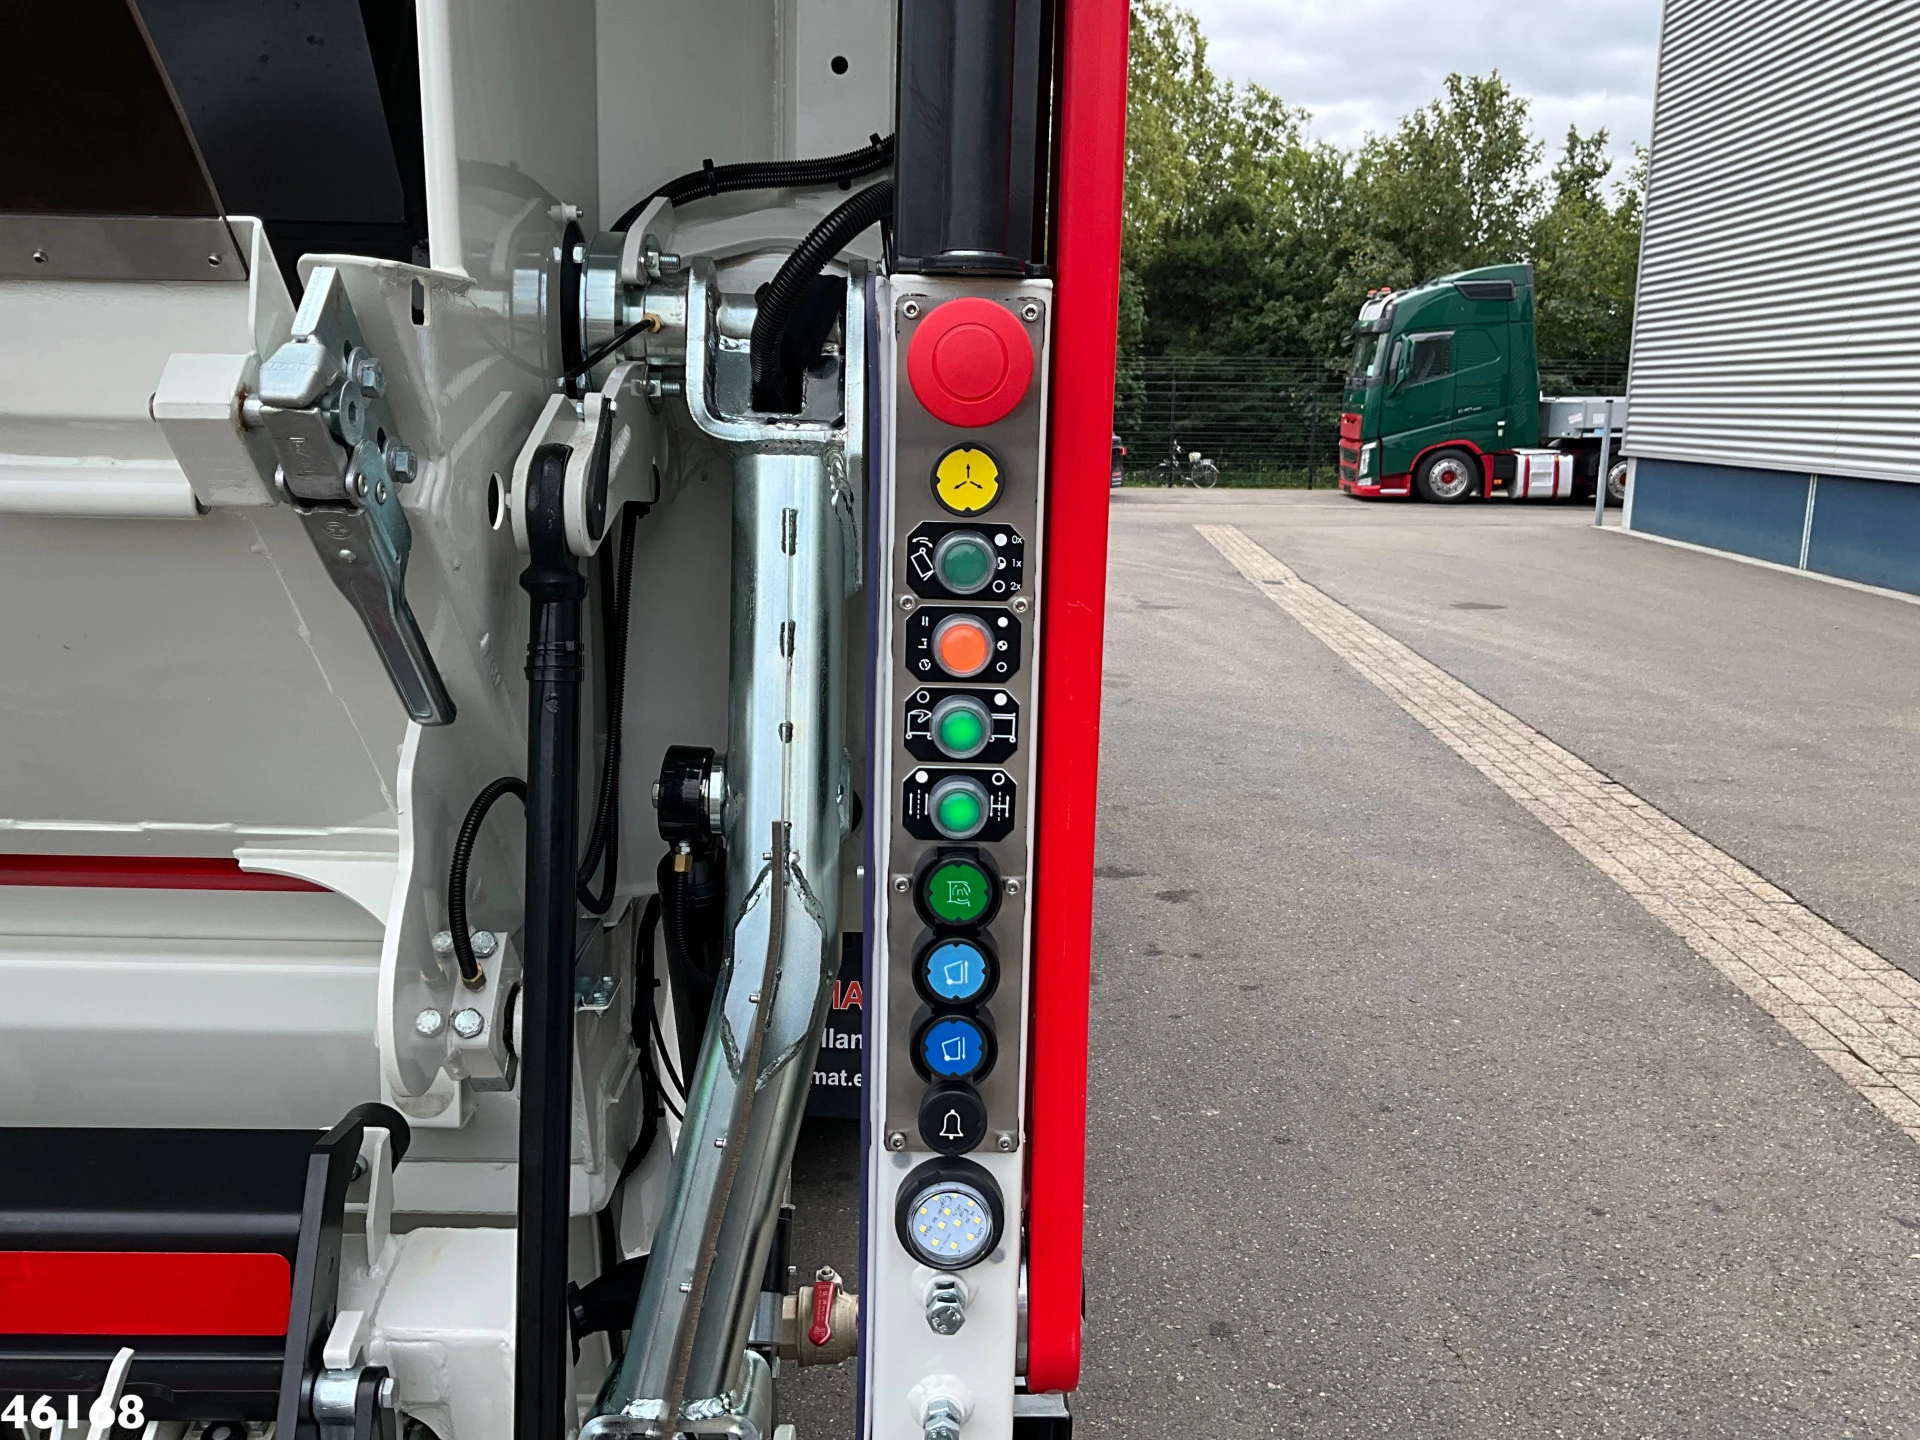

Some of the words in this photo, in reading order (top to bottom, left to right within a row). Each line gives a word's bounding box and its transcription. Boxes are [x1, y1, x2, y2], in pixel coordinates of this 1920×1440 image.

[1011, 535, 1023, 544] 0x
[1011, 558, 1022, 568] 1x
[1010, 581, 1021, 591] 2x
